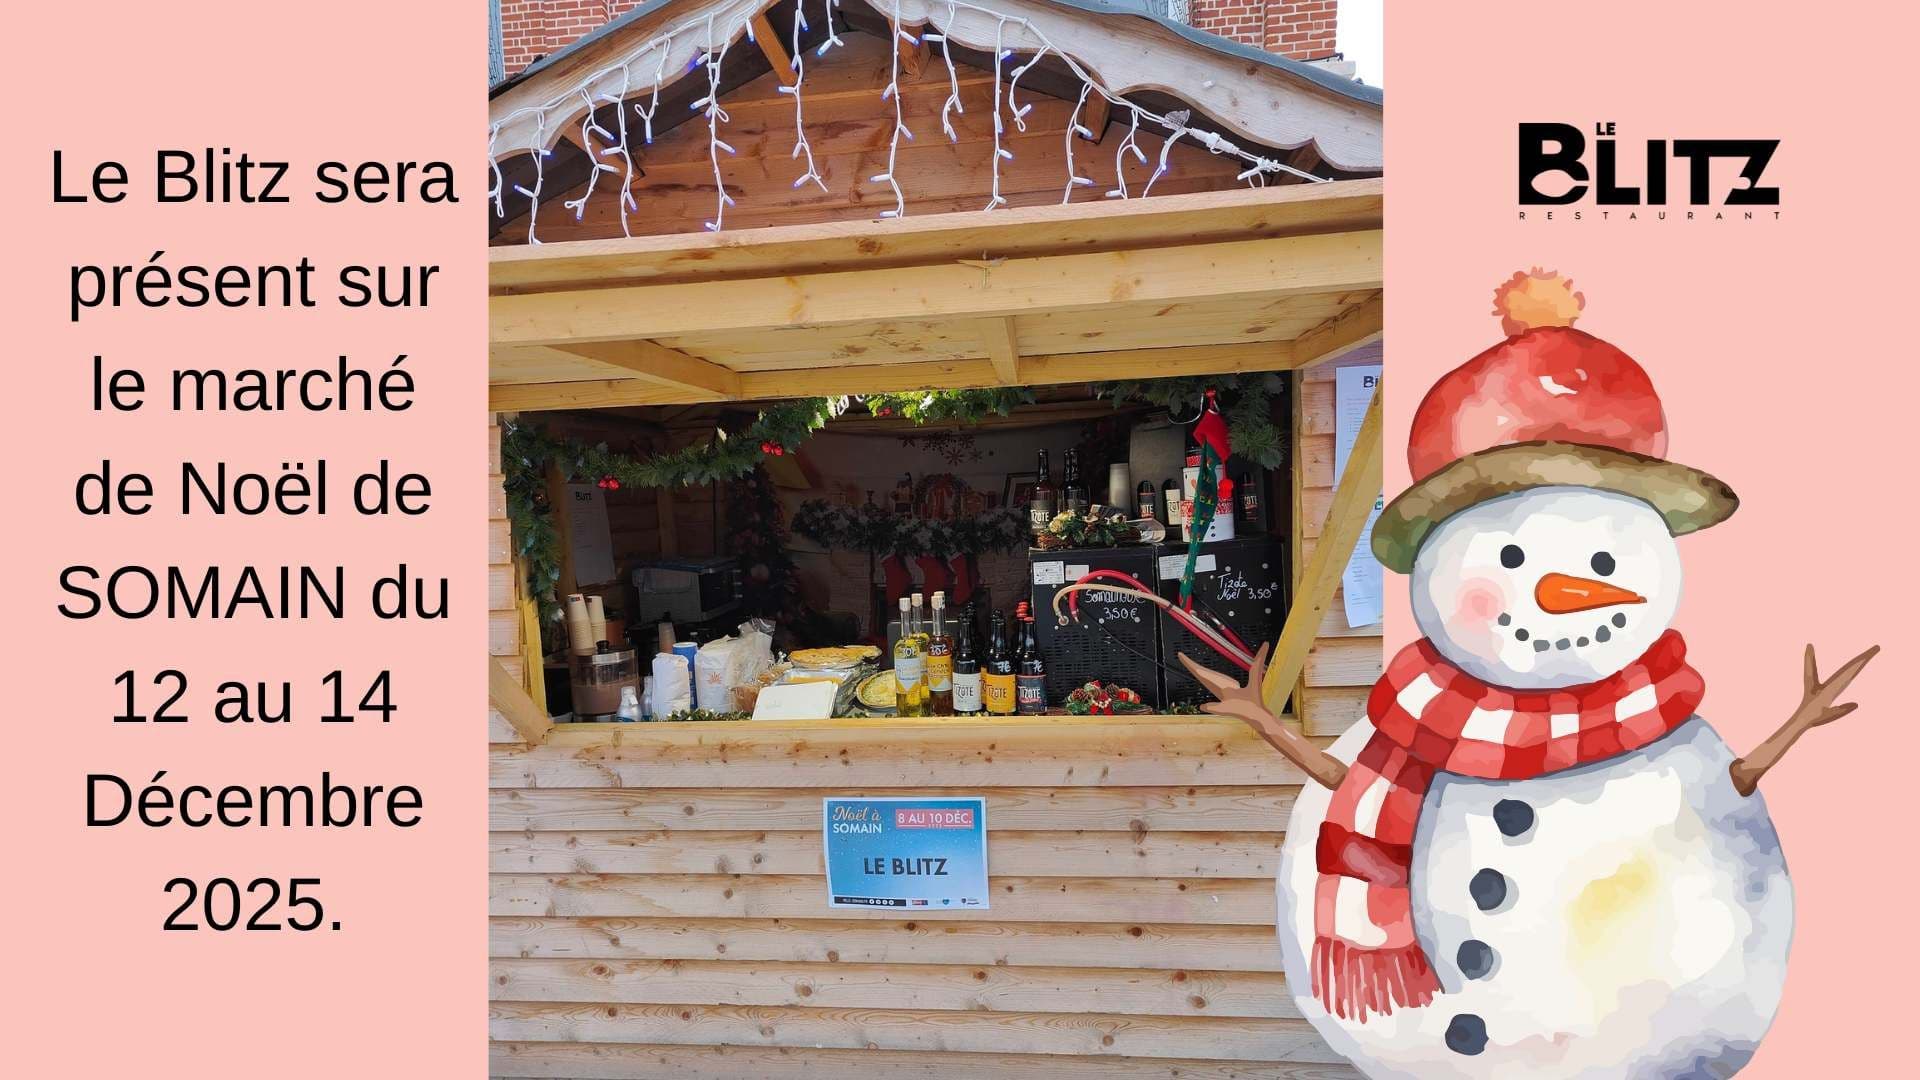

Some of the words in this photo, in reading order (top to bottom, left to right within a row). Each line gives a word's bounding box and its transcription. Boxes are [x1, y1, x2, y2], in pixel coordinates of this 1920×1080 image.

[832, 806, 869, 821] Noël
[871, 809, 882, 821] à
[898, 813, 905, 824] 8
[908, 813, 925, 824] AU
[929, 813, 943, 824] 10
[945, 810, 972, 824] DÉC.
[833, 823, 882, 834] SOMAIN
[864, 858, 885, 875] LE
[892, 858, 948, 875] BLITZ
